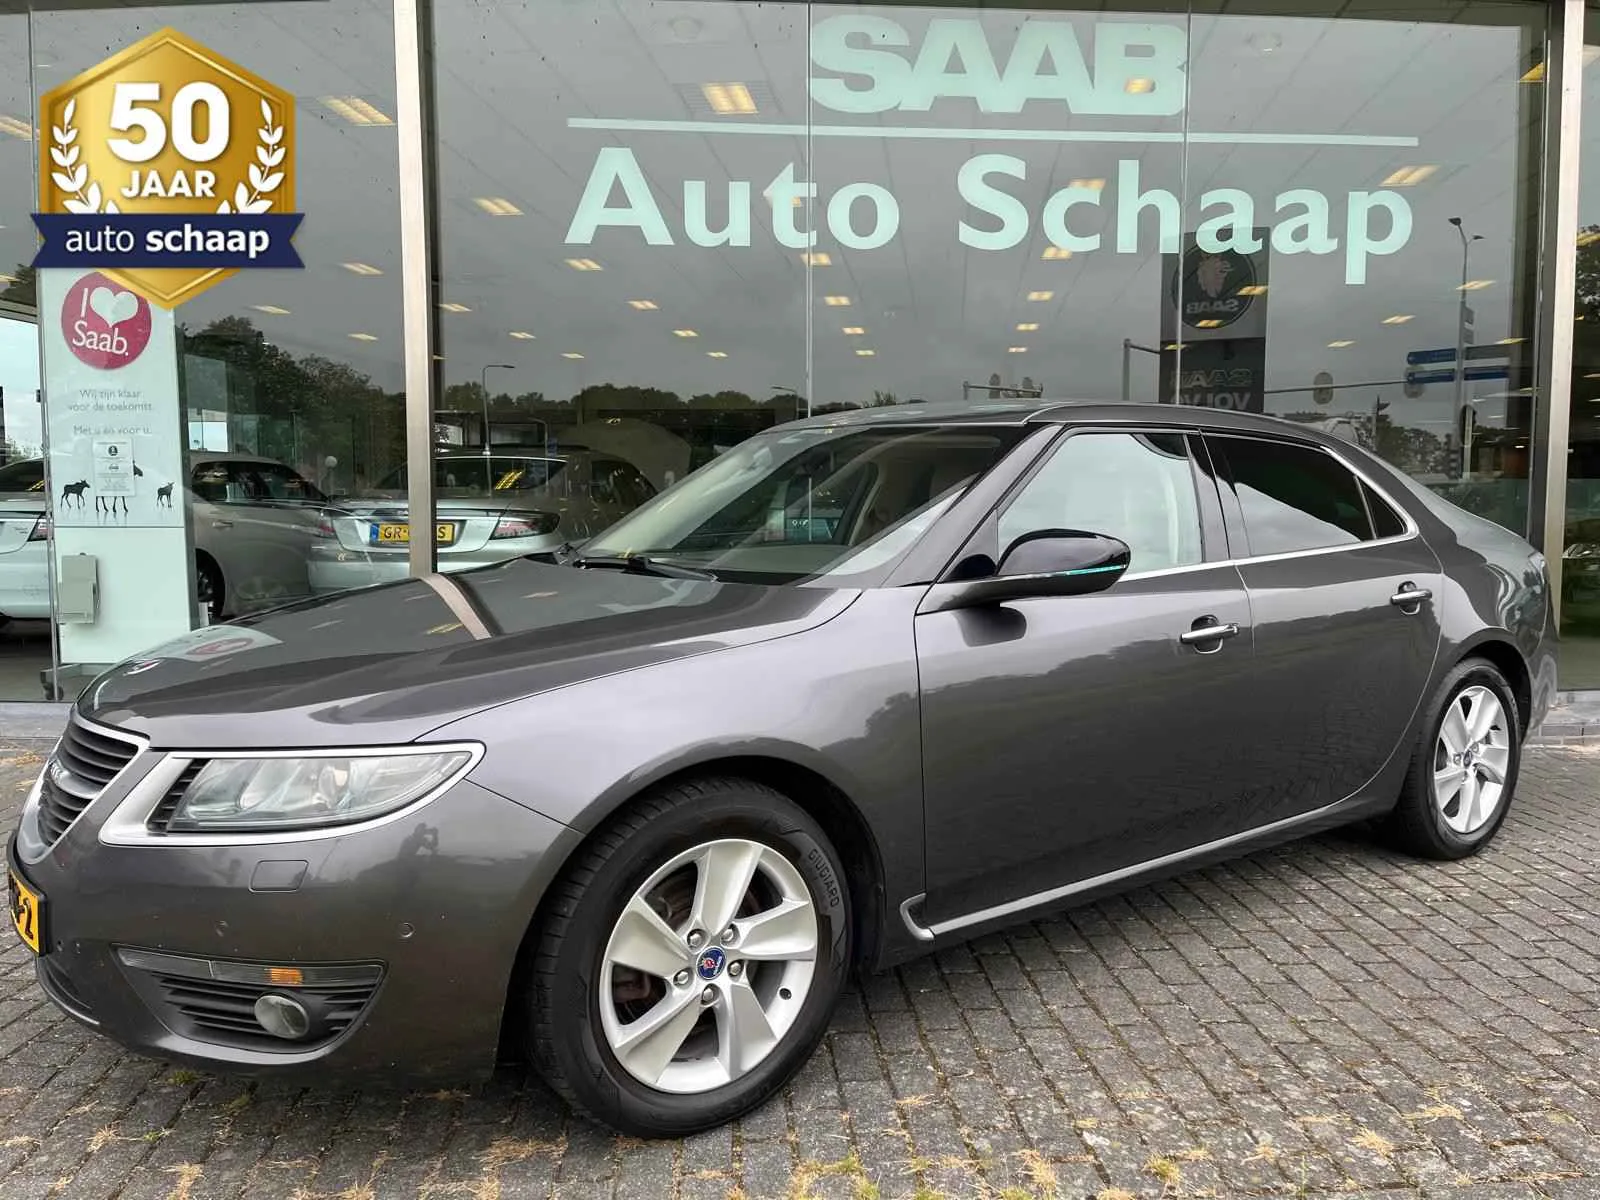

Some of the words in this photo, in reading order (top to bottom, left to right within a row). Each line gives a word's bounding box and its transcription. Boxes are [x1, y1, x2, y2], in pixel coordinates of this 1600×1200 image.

[808, 14, 1187, 116] SAAB
[564, 147, 900, 250] Auto
[957, 153, 1413, 285] Schaap
